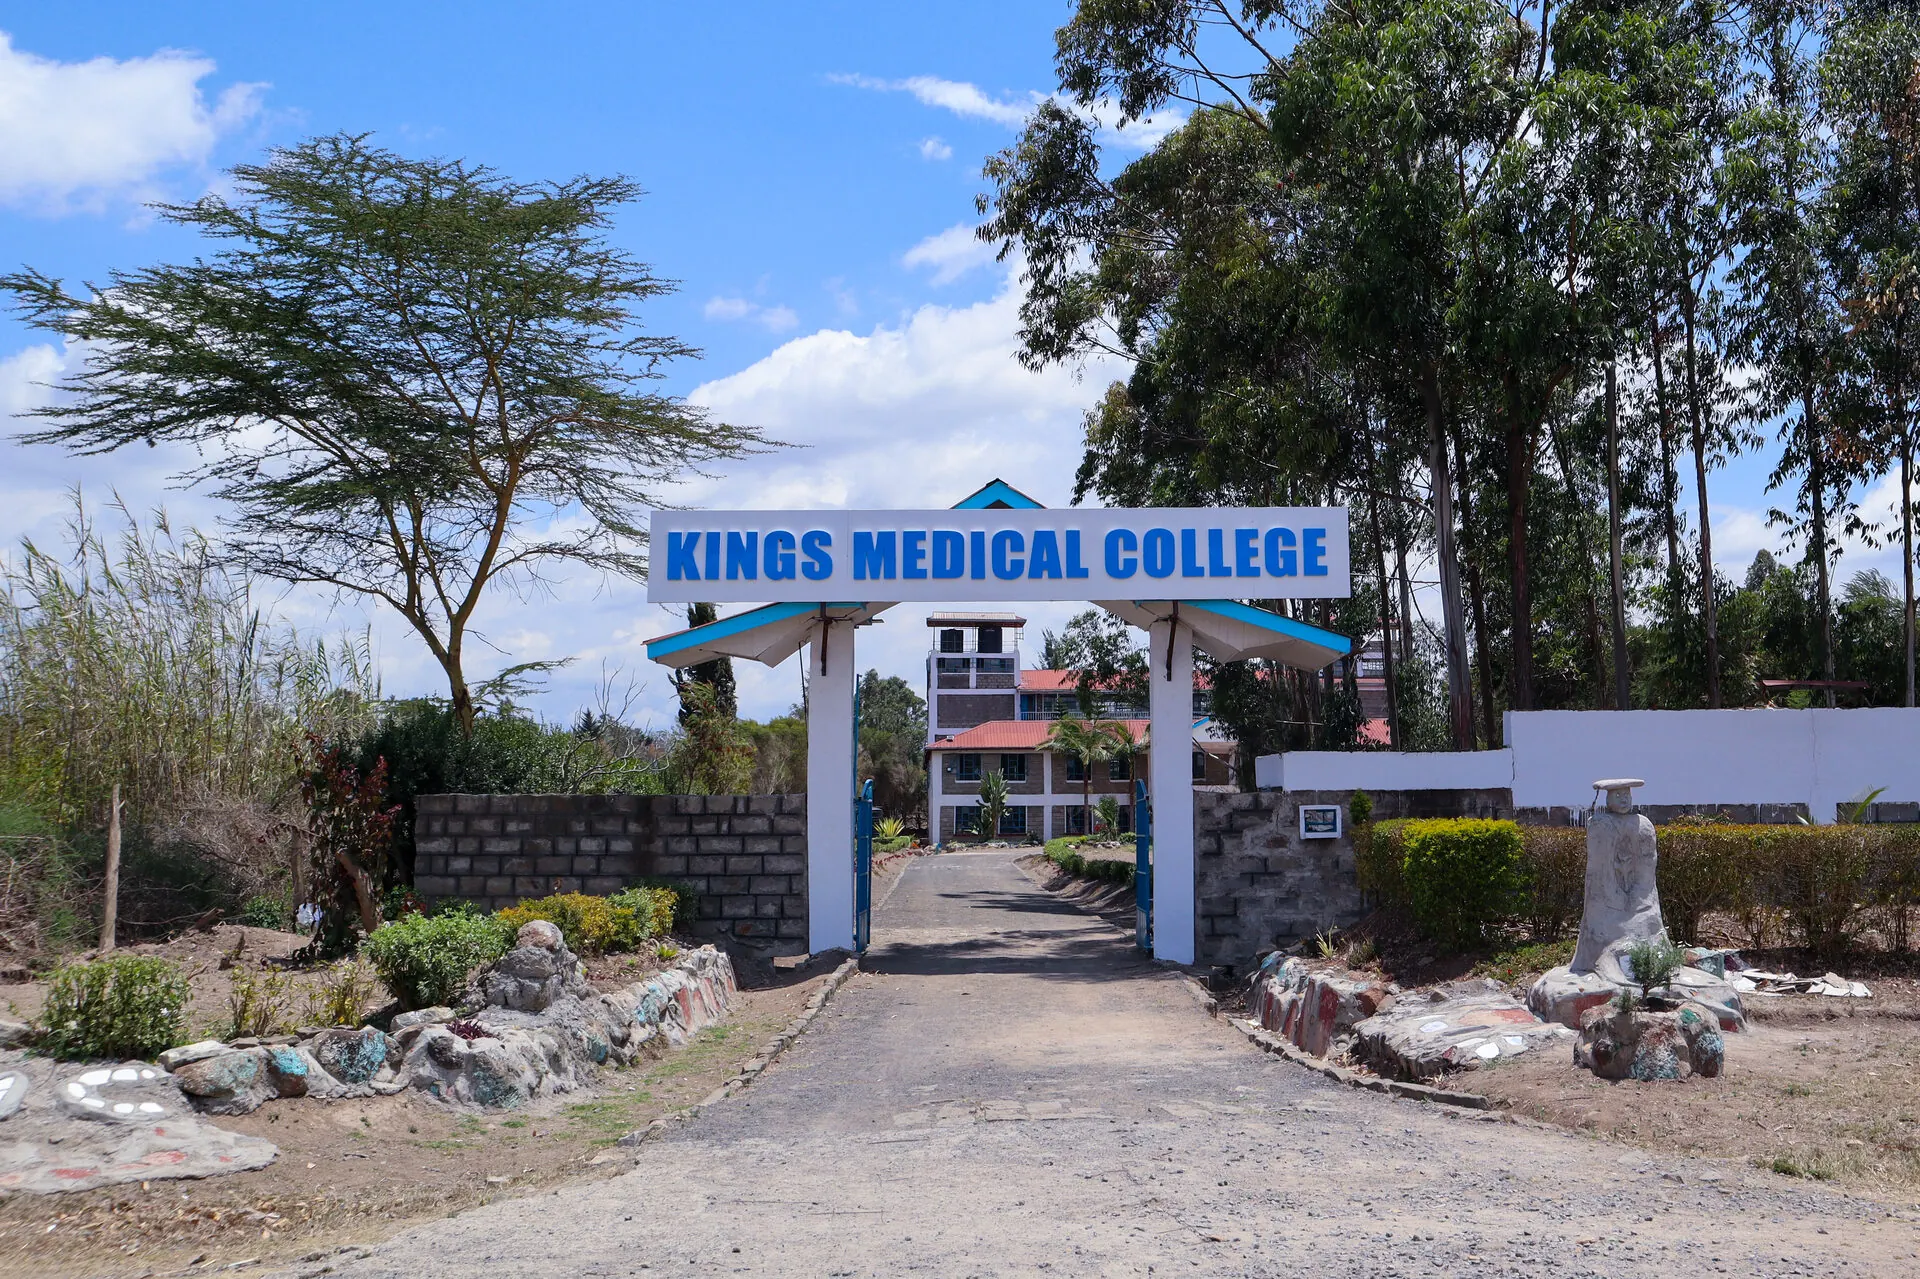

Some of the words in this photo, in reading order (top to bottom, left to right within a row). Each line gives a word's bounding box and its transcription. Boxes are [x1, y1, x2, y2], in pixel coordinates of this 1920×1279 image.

[667, 531, 833, 580] KINGS
[853, 530, 1089, 580] MEDICAL
[1105, 528, 1328, 578] COLLEGE
